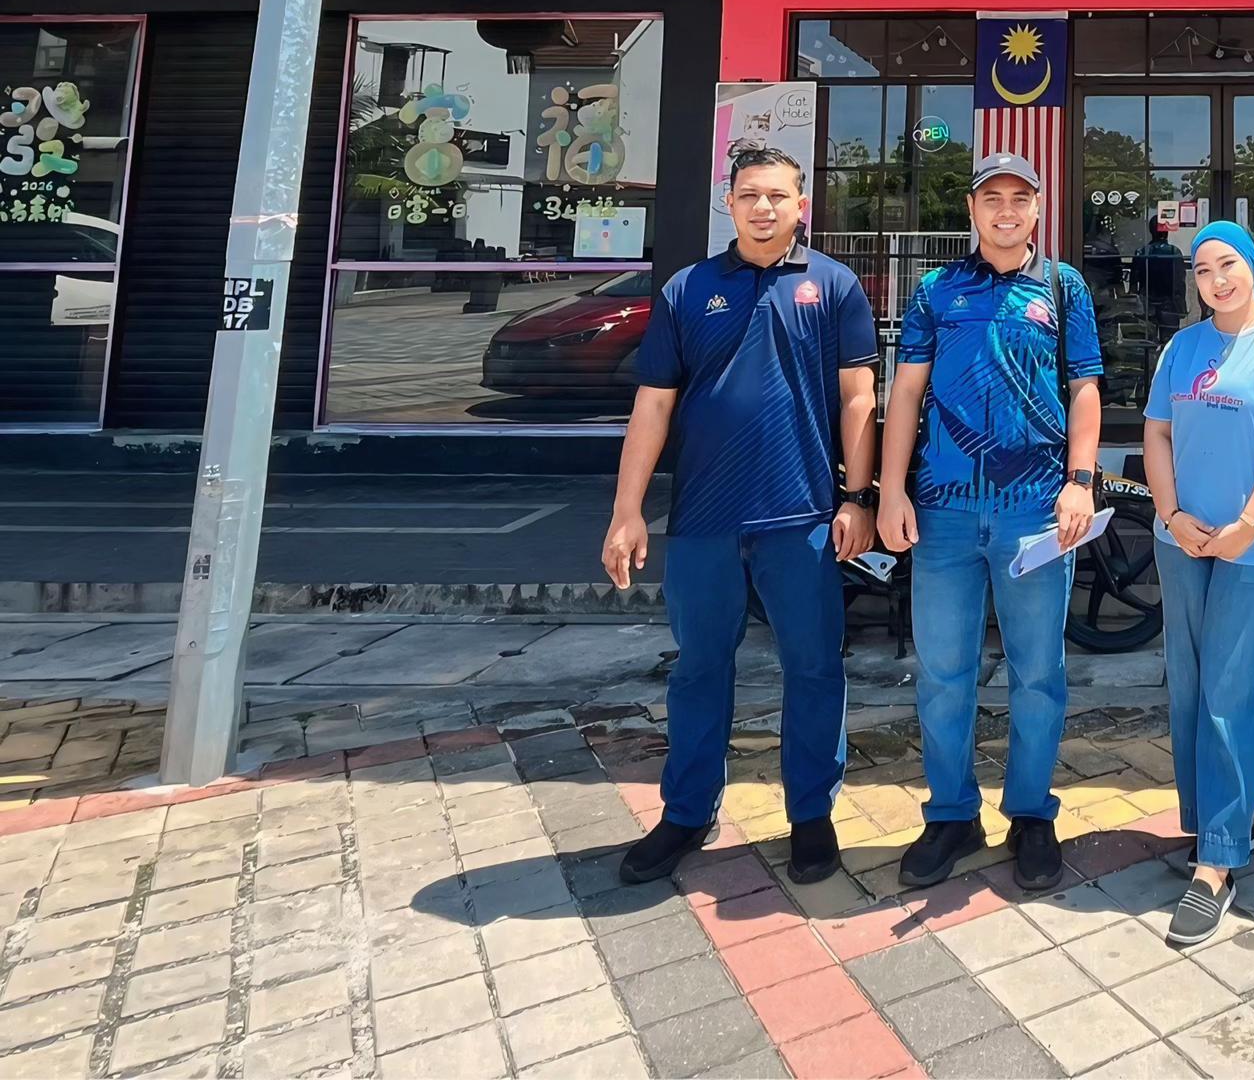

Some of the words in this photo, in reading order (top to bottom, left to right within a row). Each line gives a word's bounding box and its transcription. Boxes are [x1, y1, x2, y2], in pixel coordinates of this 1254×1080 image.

[787, 94, 808, 107] Cat
[782, 108, 813, 119] Hotel
[913, 126, 949, 141] OPEN
[21, 181, 54, 191] 2026
